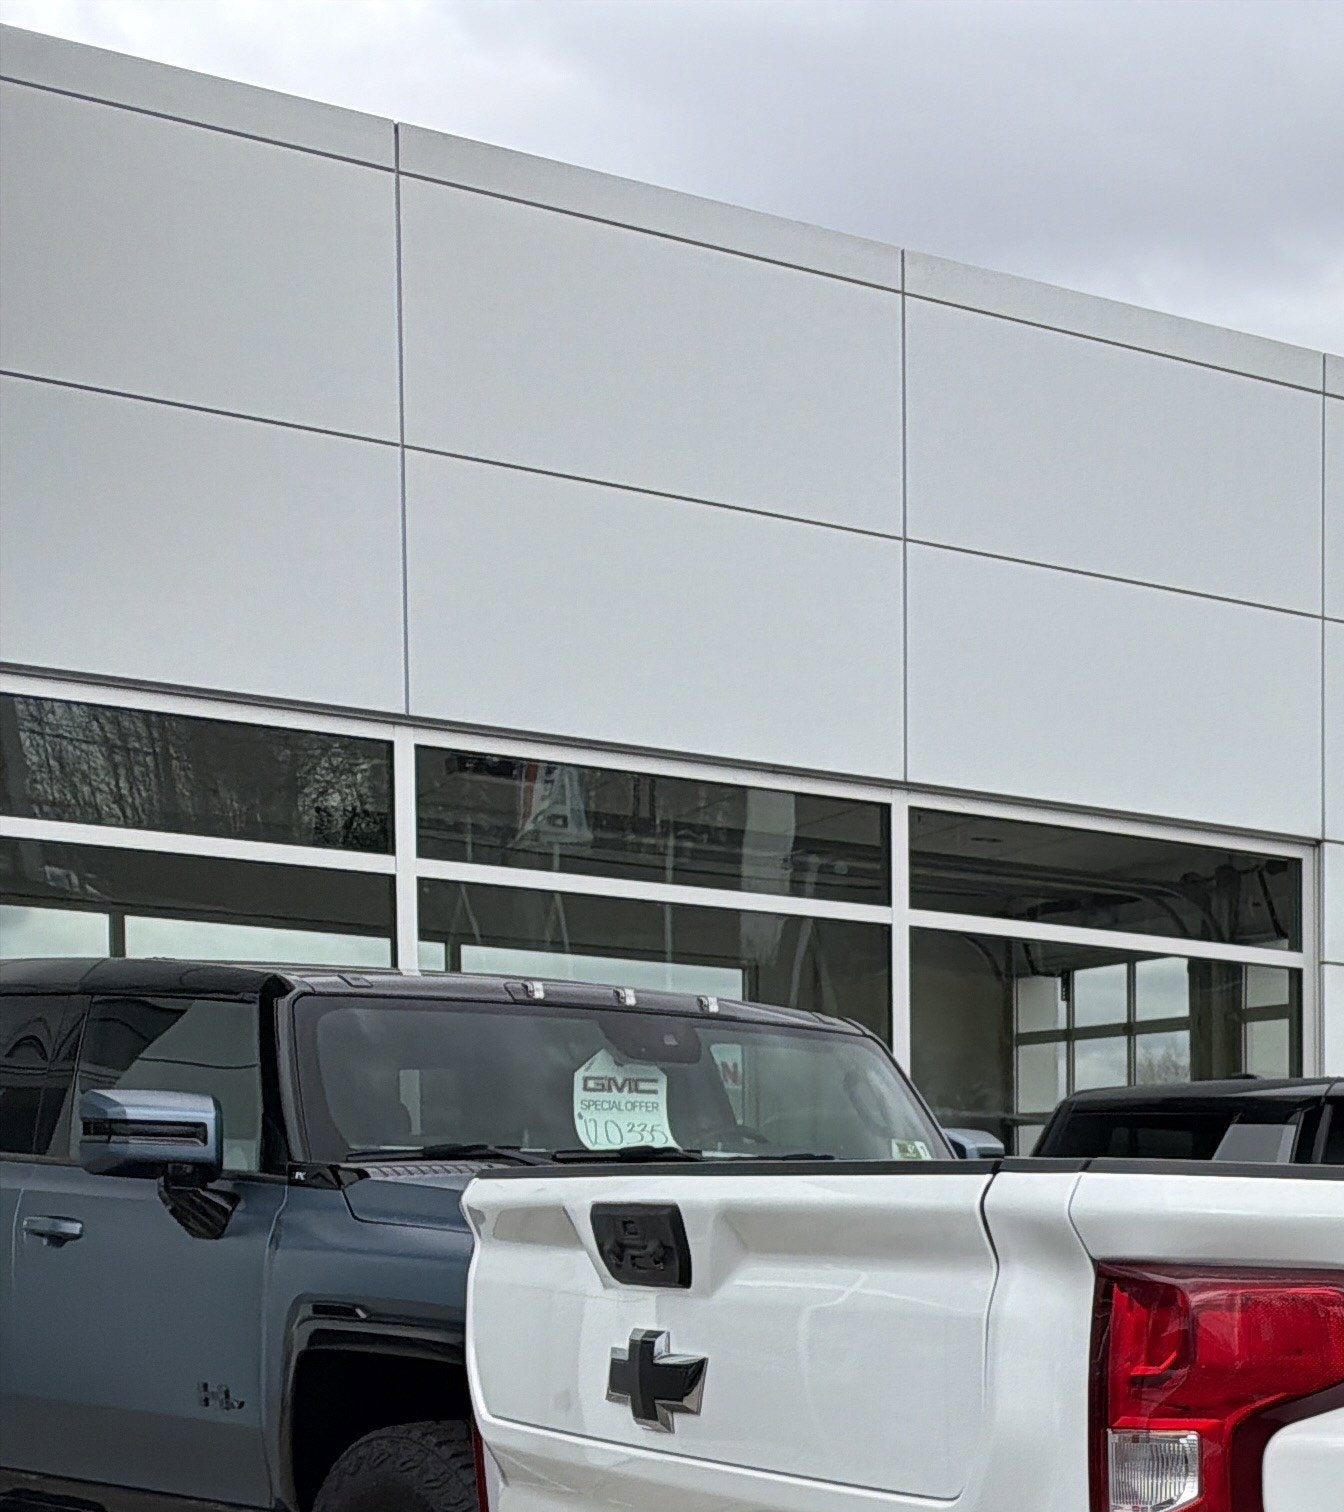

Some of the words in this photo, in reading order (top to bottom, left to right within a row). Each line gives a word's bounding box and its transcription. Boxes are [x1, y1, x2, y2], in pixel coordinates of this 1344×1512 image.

[582, 1075, 659, 1095] GMC
[580, 1099, 624, 1112] SPECIAL
[624, 1101, 660, 1113] OFFER
